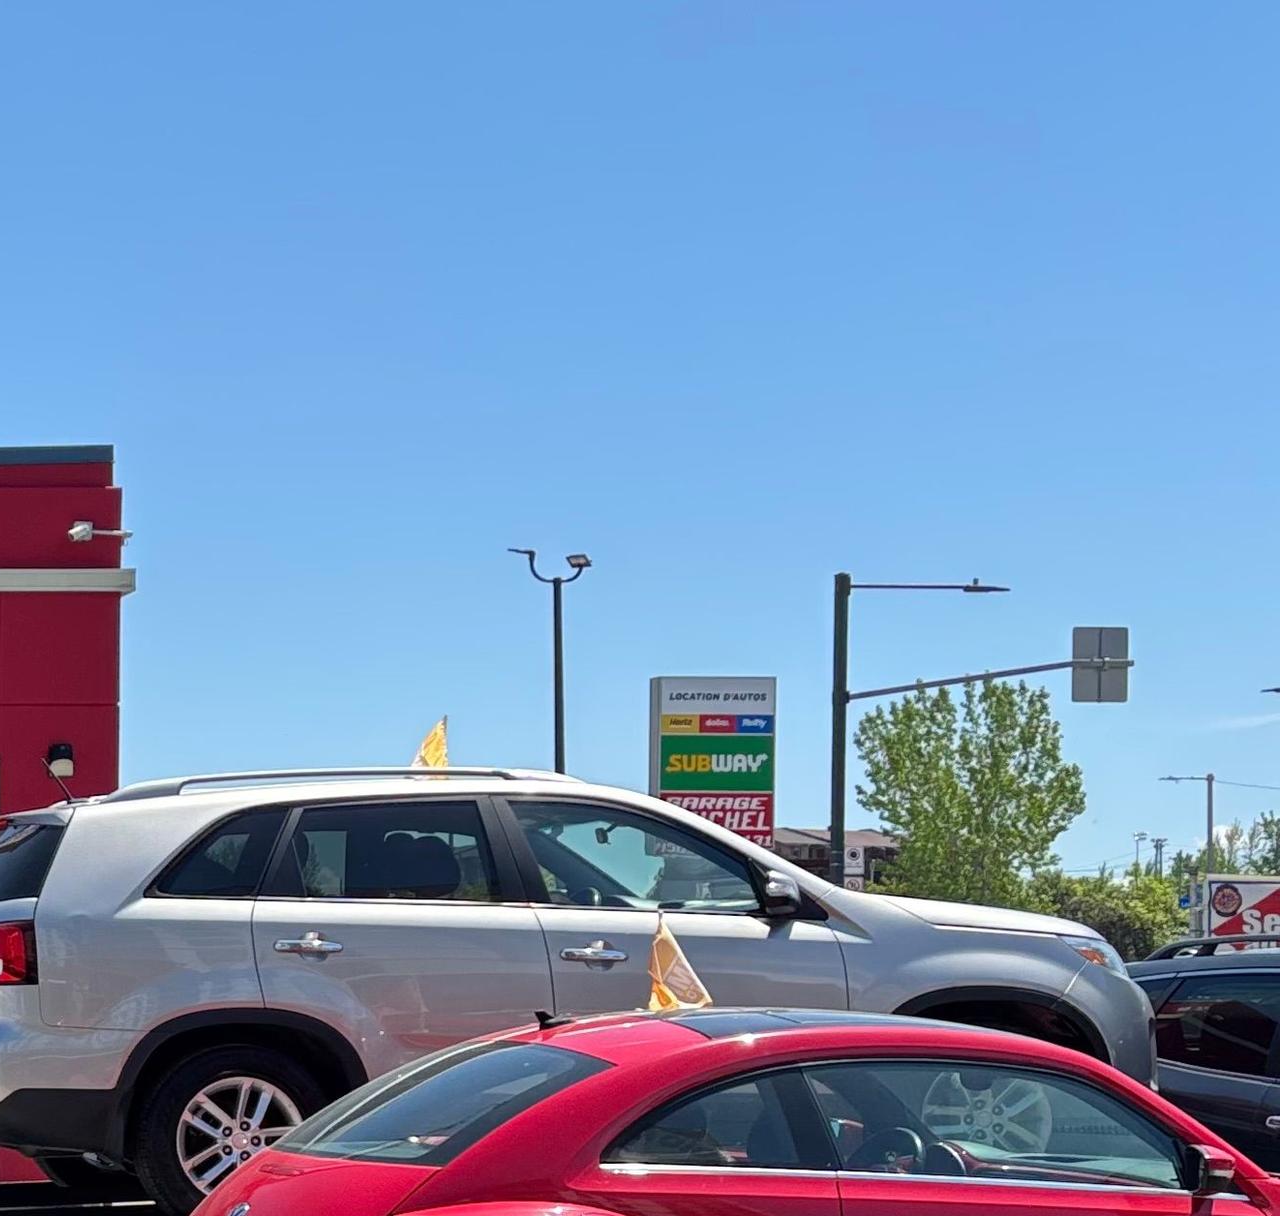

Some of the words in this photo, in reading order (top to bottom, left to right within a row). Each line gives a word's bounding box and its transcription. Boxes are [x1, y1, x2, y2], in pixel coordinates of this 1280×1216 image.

[669, 692, 720, 701] LOCATION
[723, 692, 768, 701] D'AUTOS
[665, 753, 769, 773] SUBWAY
[694, 810, 770, 830] CHEL
